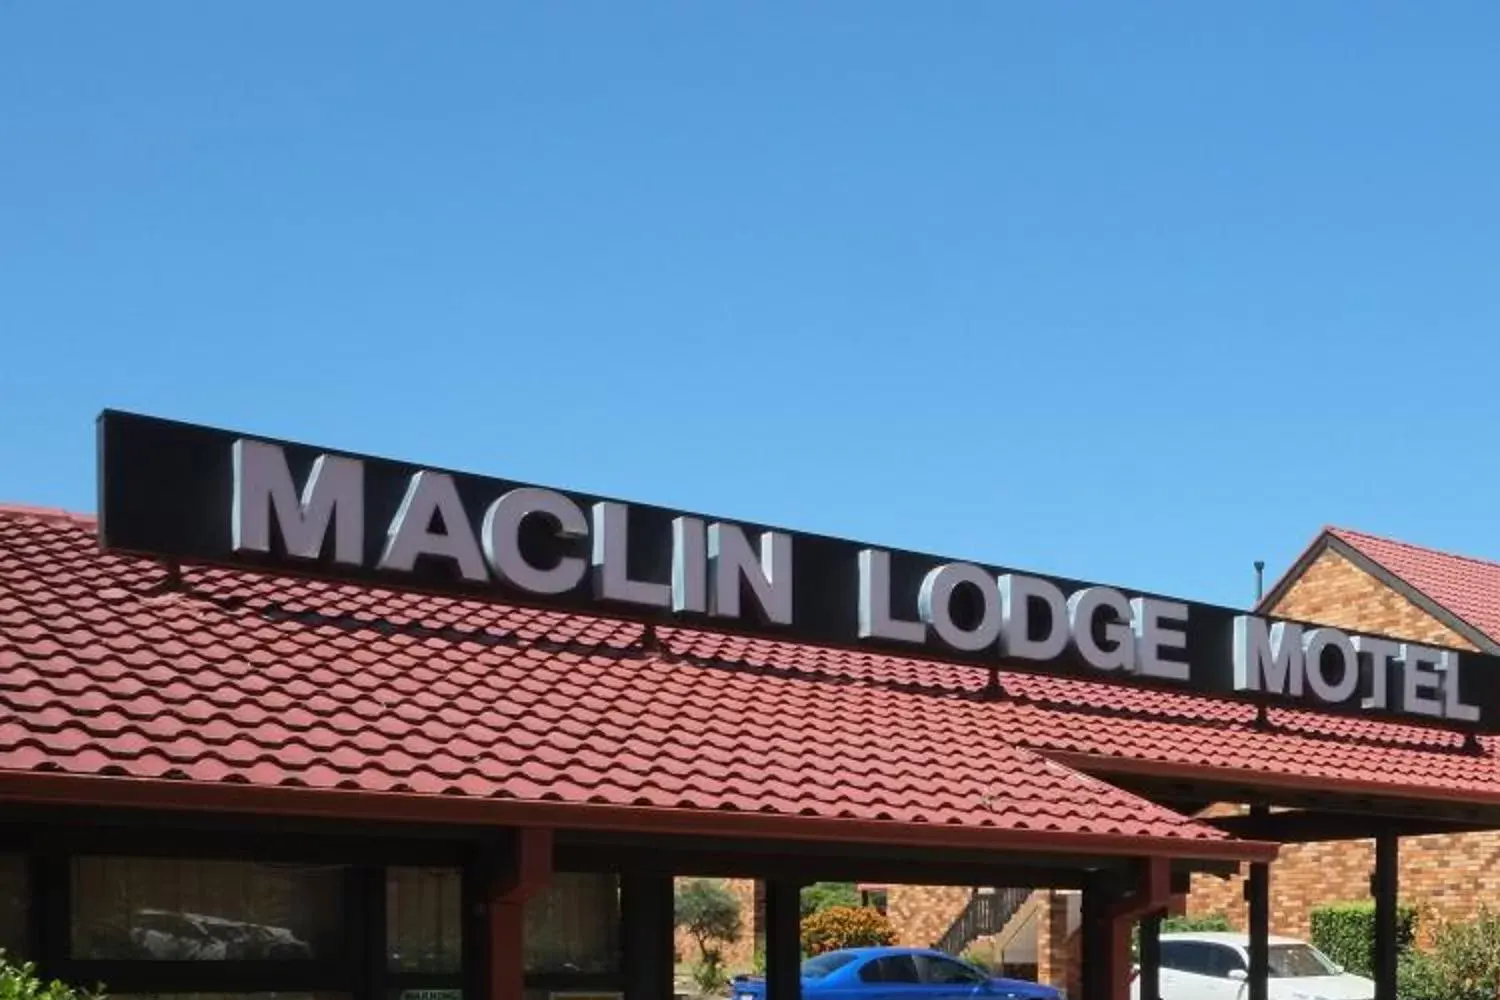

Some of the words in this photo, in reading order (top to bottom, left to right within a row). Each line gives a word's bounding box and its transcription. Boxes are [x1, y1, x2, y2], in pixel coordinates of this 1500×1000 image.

[232, 438, 793, 625] MACLIN
[858, 549, 1190, 681] LODGE
[1233, 615, 1481, 722] MOTEL
